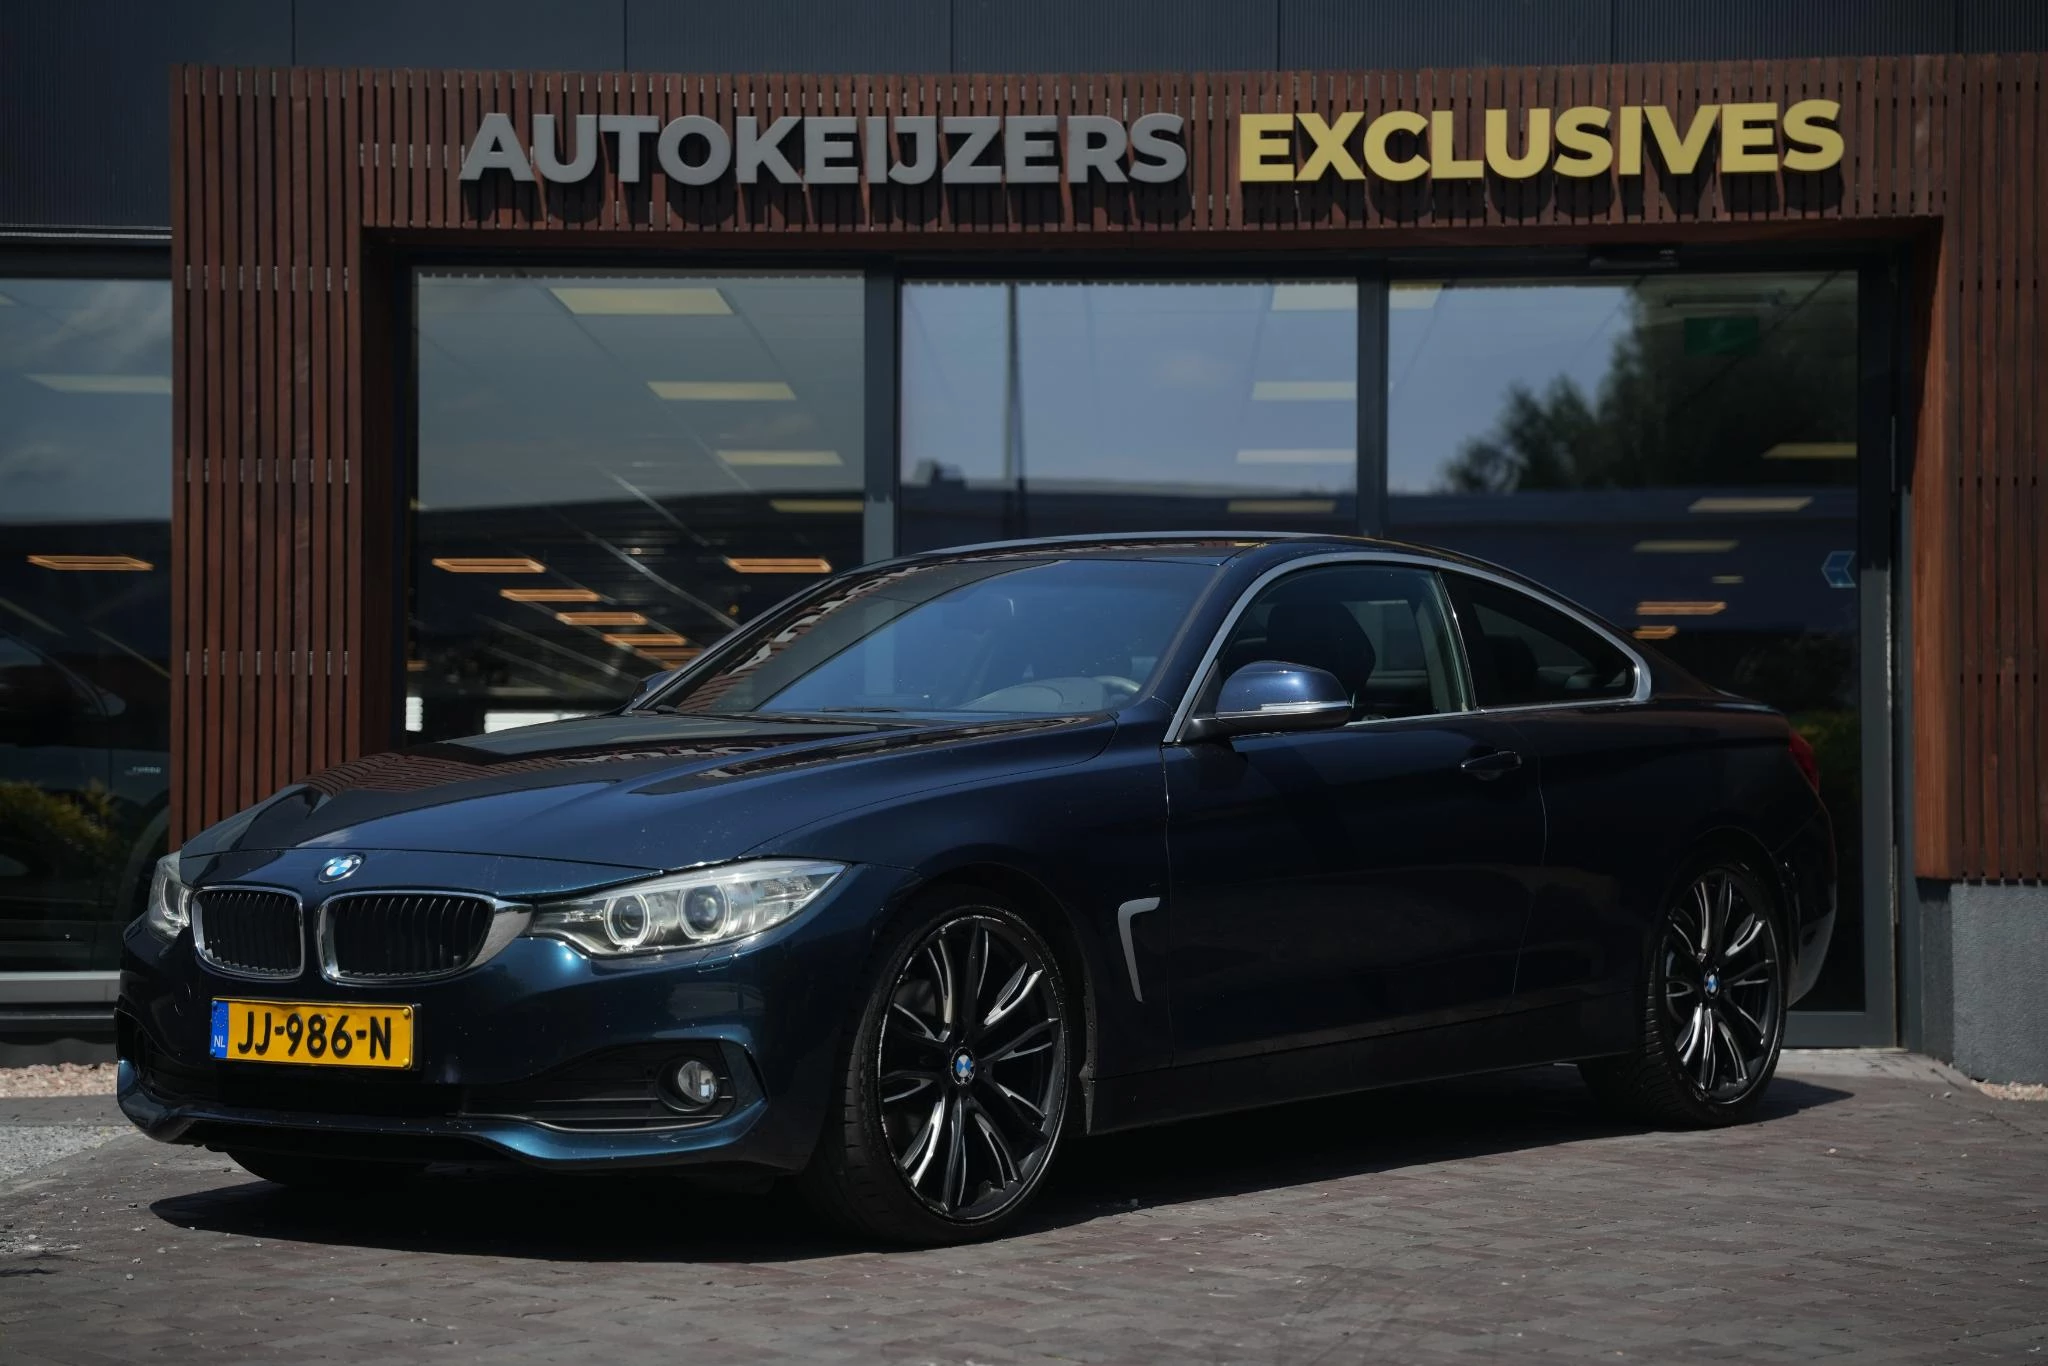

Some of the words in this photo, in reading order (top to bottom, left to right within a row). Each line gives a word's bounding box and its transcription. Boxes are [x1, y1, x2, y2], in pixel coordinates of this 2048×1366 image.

[459, 112, 1188, 184] AUTOKEIJZERS
[1240, 99, 1845, 181] EXCLUSIVES
[213, 1035, 226, 1048] NL
[237, 1011, 392, 1060] JJ-986-N
